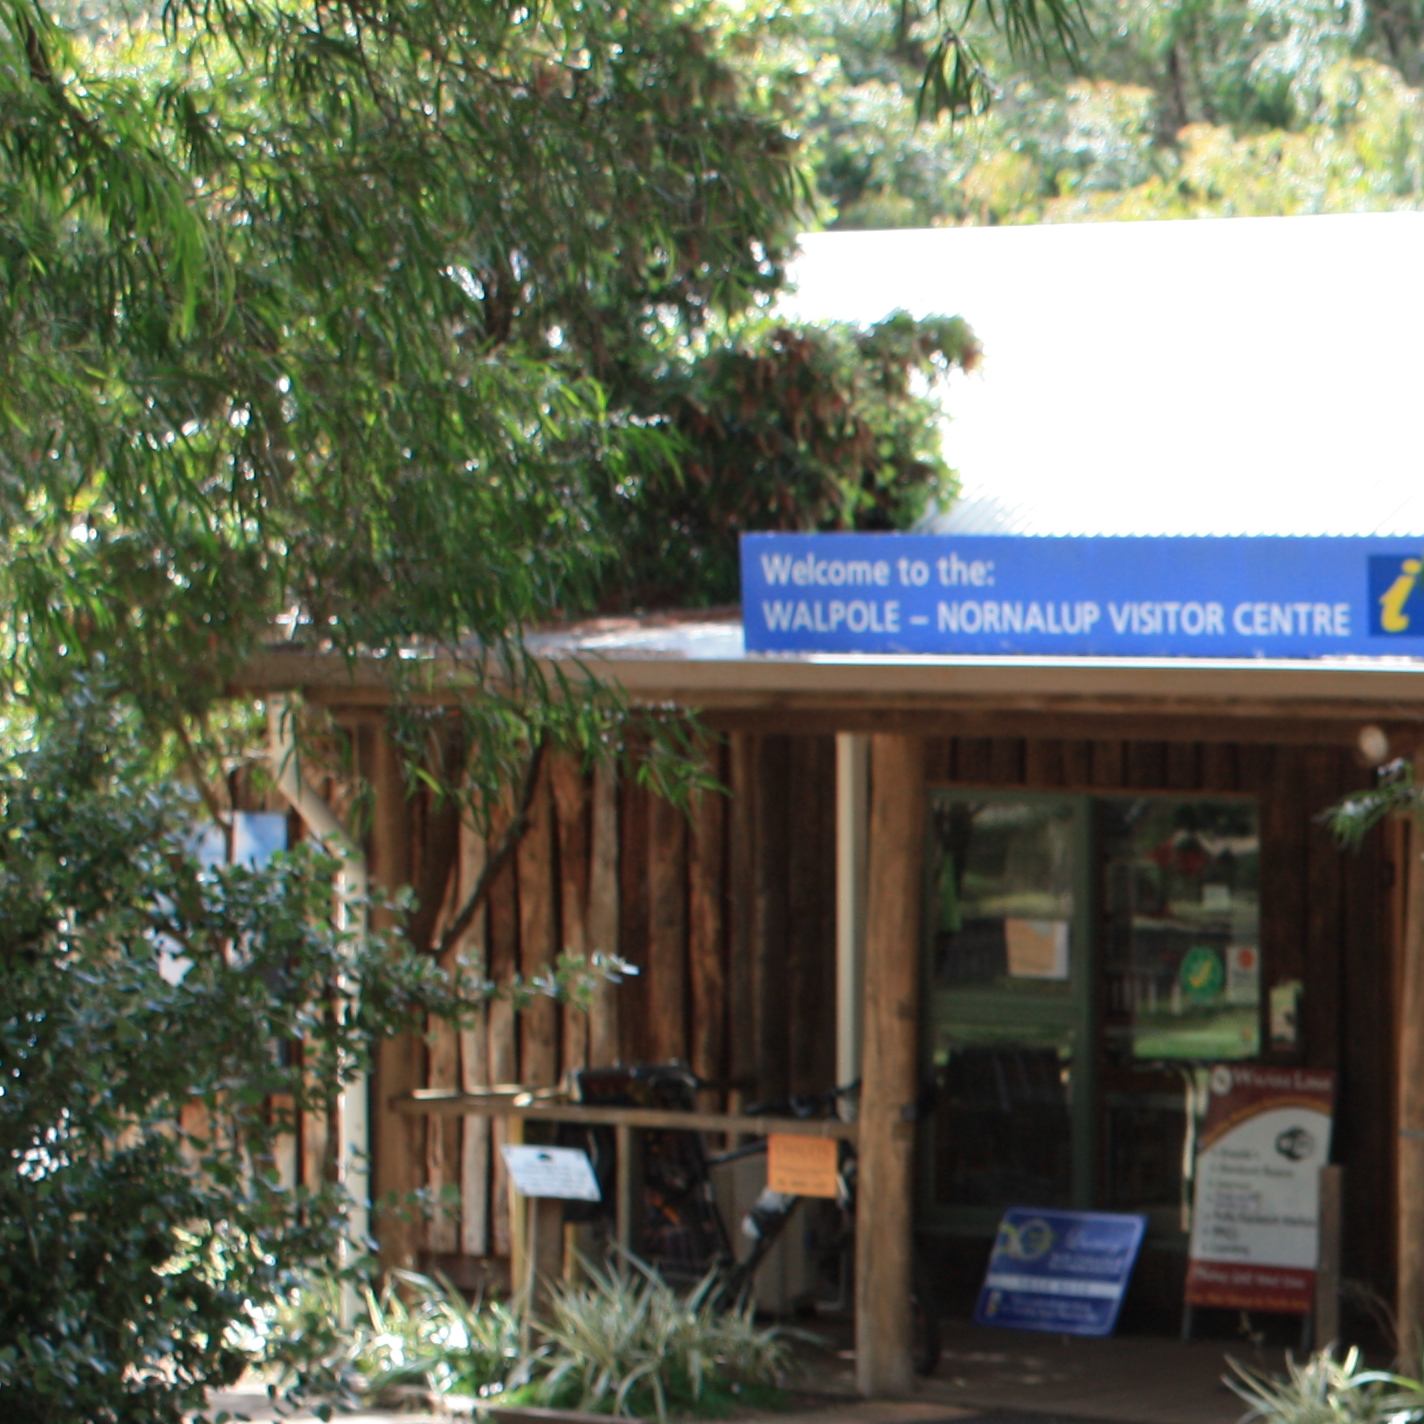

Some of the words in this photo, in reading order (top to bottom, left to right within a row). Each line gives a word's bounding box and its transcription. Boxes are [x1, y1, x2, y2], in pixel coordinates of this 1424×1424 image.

[761, 554, 889, 587] Welcome
[898, 556, 930, 587] to
[938, 555, 995, 587] the:
[762, 602, 900, 633] WALPOLE
[937, 602, 1100, 635] NORNALUP
[1108, 603, 1225, 636] VISITOR
[1233, 603, 1352, 637] CENTRE
